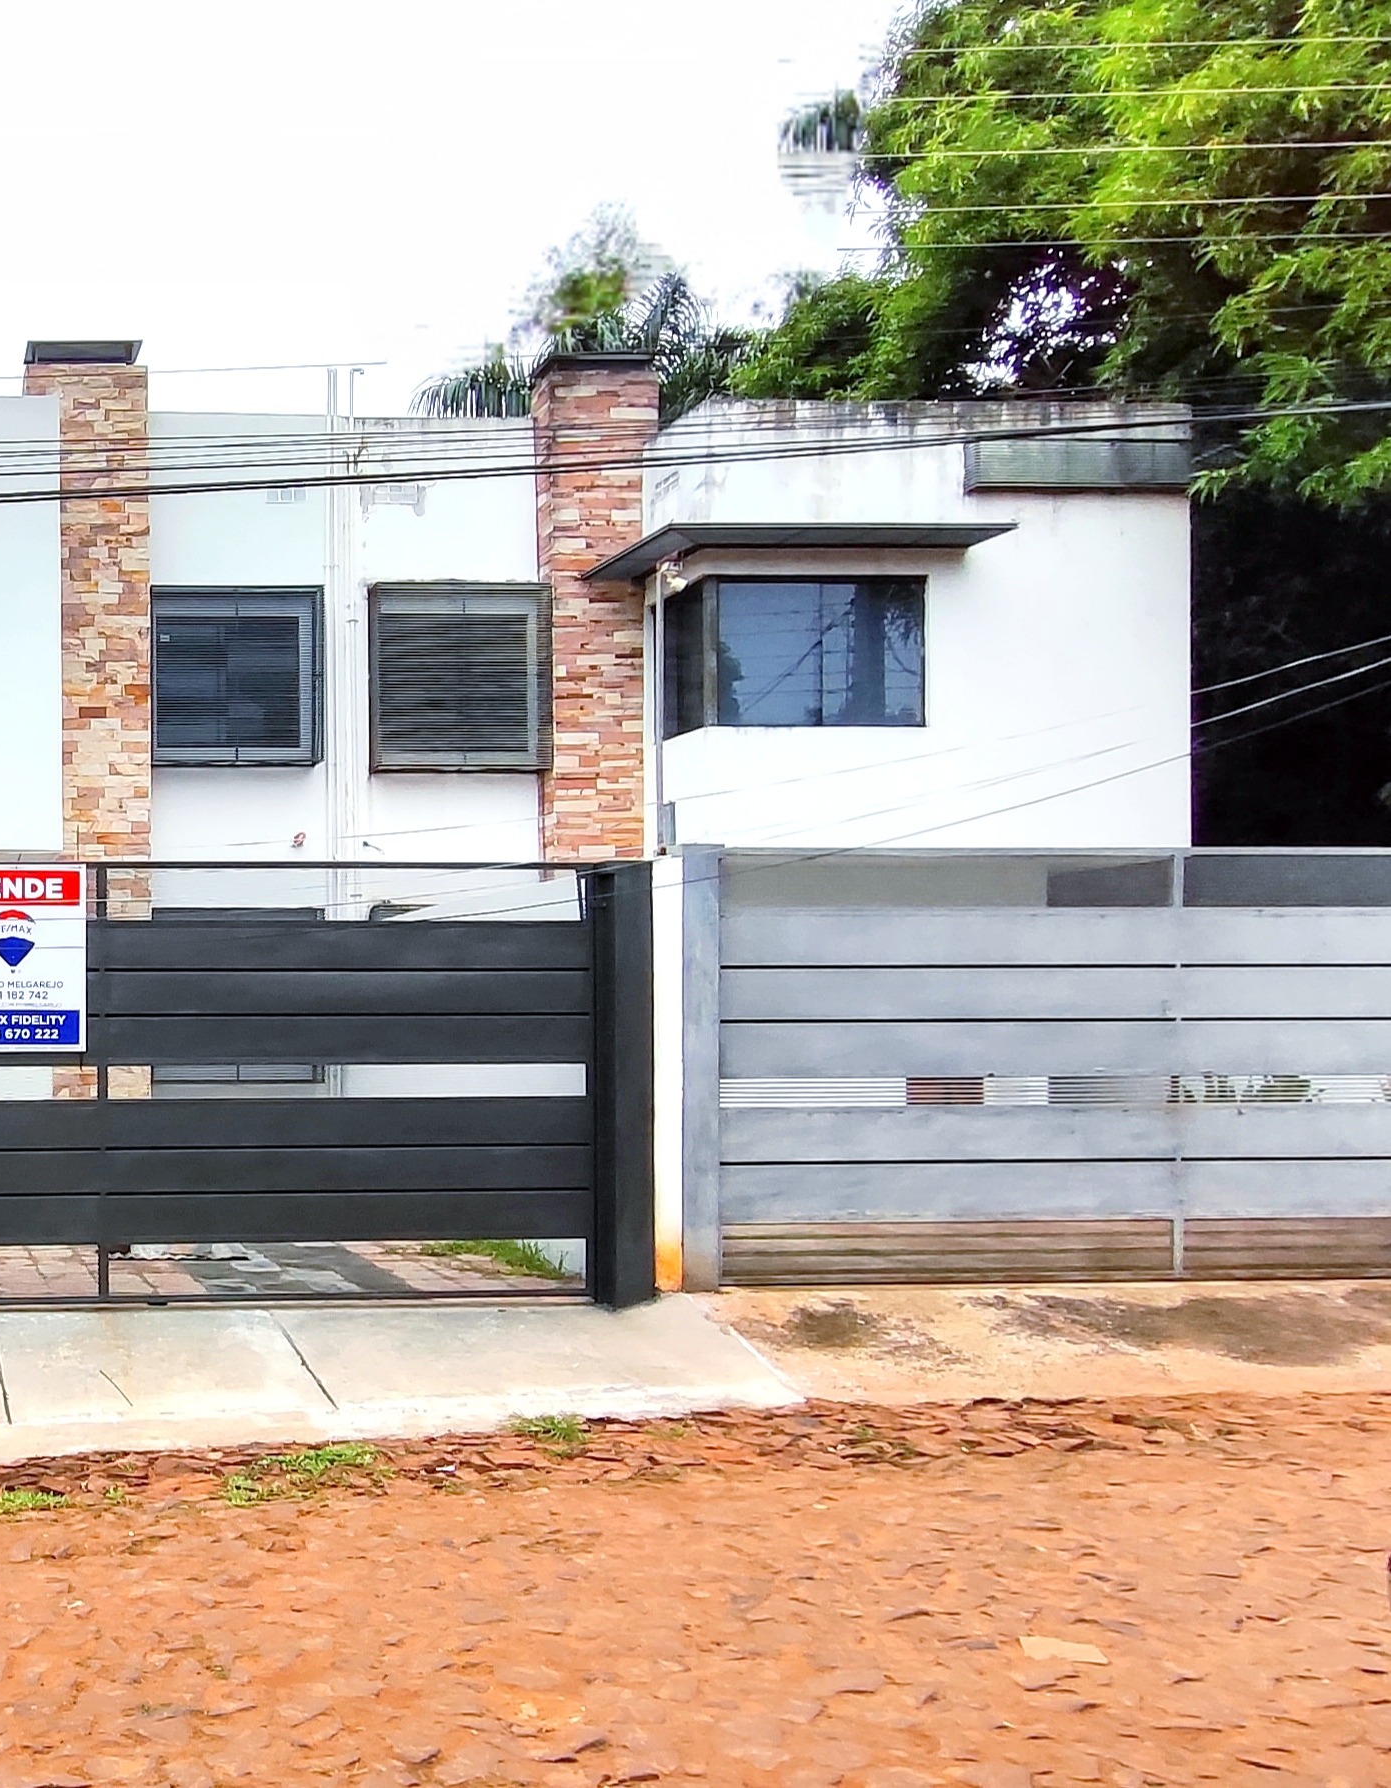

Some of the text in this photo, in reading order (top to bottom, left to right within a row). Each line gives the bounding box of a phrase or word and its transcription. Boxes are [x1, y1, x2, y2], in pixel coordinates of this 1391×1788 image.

[7, 980, 64, 989] MELGAREJO
[7, 990, 24, 1000] 182
[28, 990, 48, 1000] 742
[11, 1014, 67, 1025] FIDELITY
[4, 1028, 30, 1040] 670
[34, 1028, 59, 1040] 222
